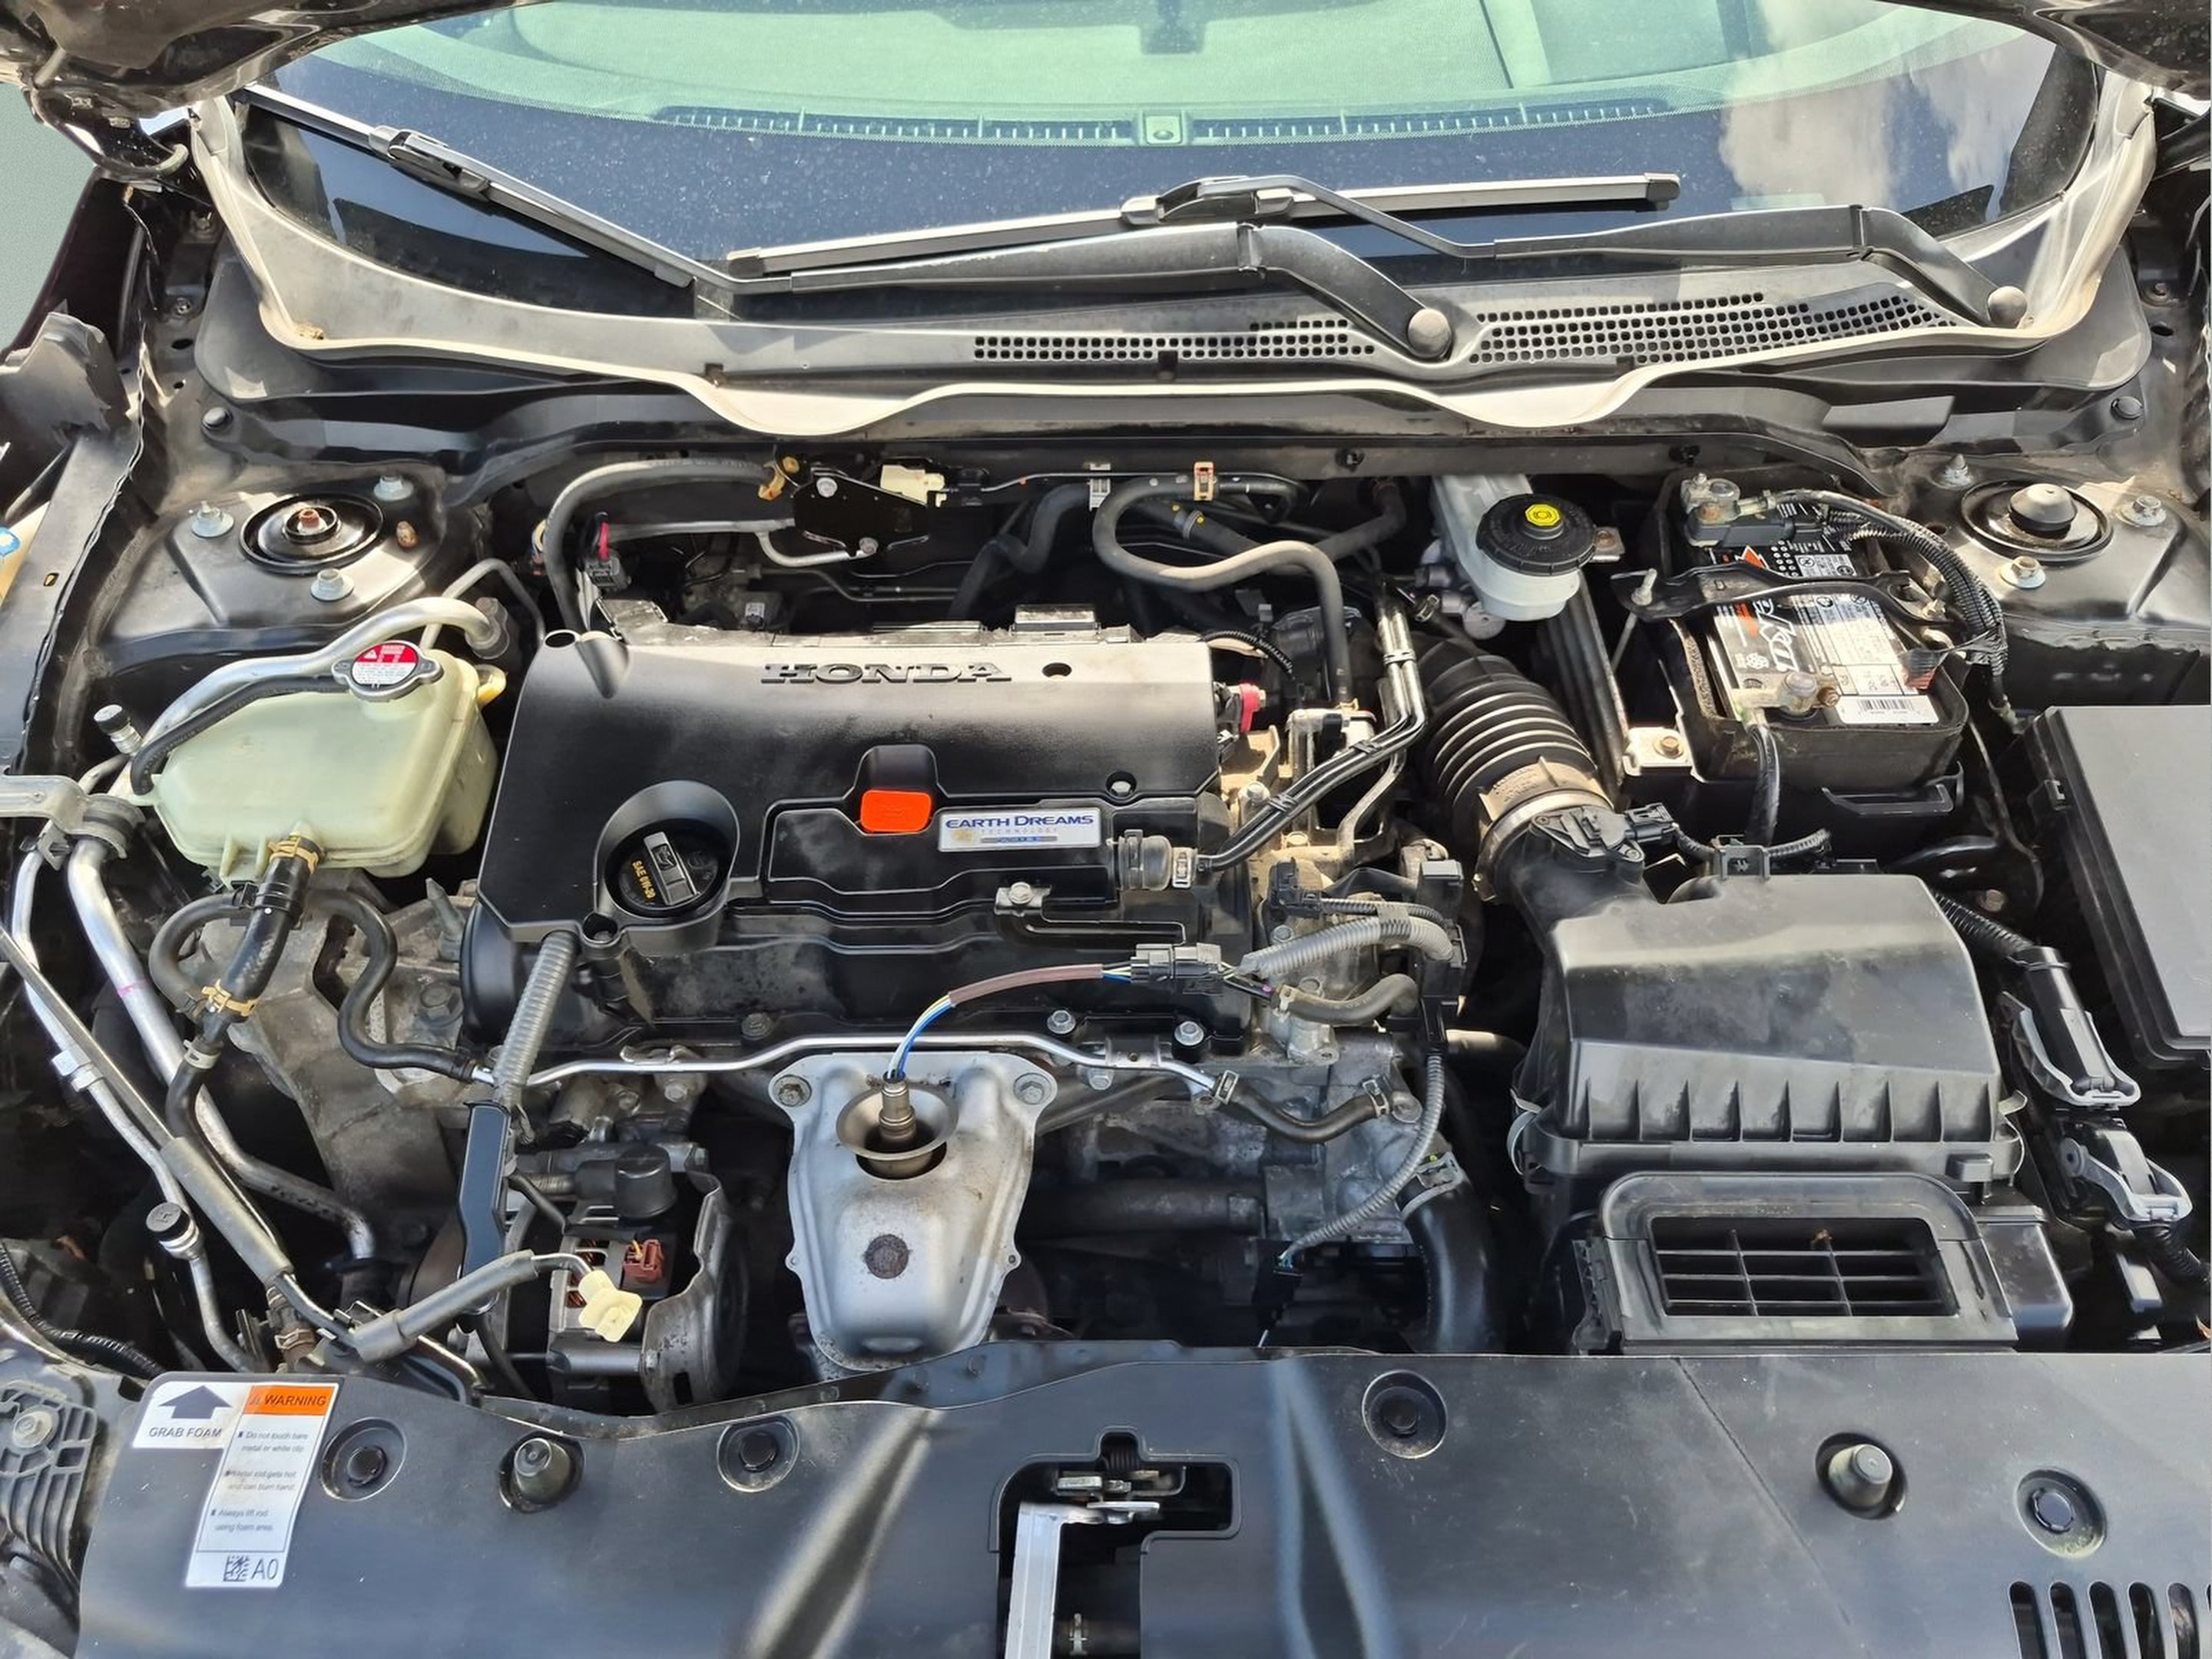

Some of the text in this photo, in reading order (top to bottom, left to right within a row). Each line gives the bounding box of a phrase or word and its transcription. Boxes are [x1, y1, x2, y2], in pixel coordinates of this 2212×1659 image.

[761, 663, 1012, 684] HONDA
[945, 815, 1094, 829] EARTH DREAMS
[631, 860, 647, 878] SAE
[264, 1395, 327, 1406] WARNING
[149, 1427, 223, 1438] GRAB FOAM
[217, 1509, 244, 1518] Always
[215, 1524, 235, 1533] using
